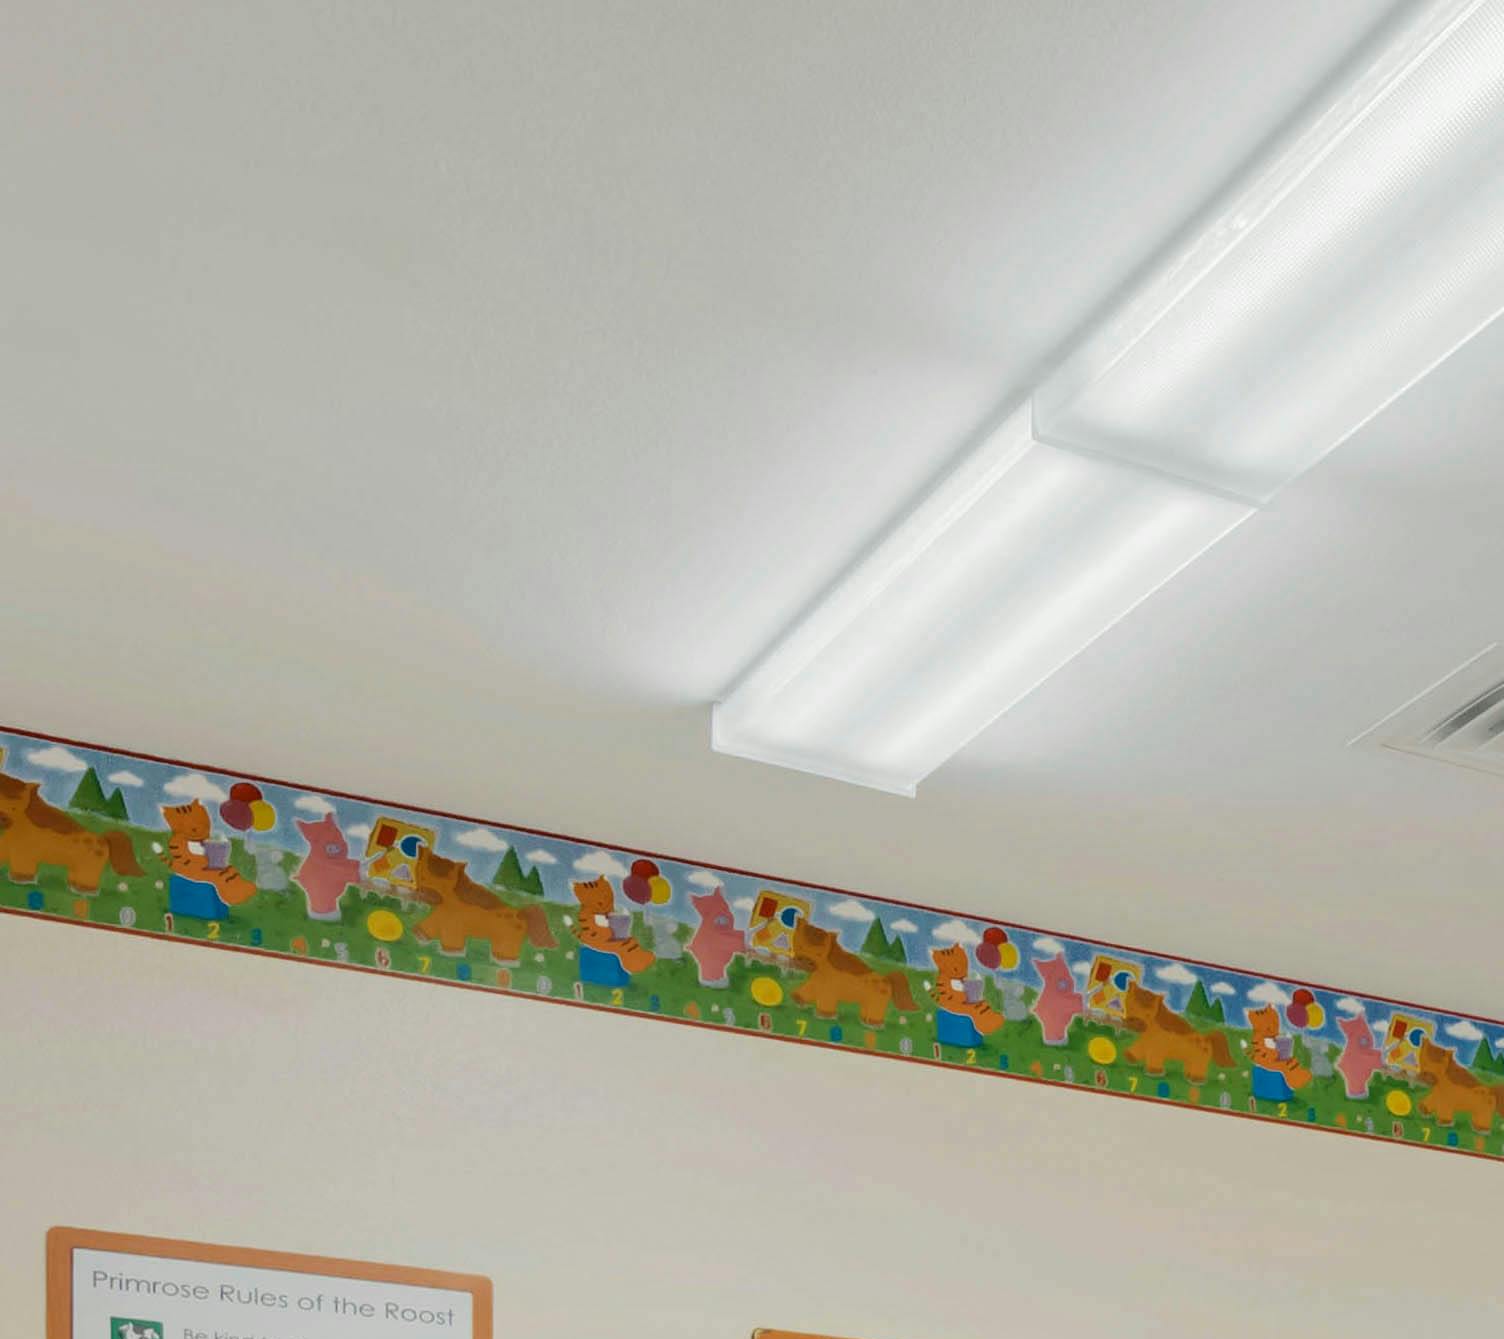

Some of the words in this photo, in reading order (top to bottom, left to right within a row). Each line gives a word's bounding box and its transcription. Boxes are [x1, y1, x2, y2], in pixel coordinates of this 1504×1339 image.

[165, 913, 173, 932] 1
[208, 921, 220, 939] 2
[418, 956, 431, 972] 7
[612, 989, 623, 1005] 2
[796, 1020, 807, 1036] 7
[967, 1049, 976, 1064] 2
[1129, 1077, 1138, 1093] 7
[1279, 1103, 1287, 1117] 2
[92, 1270, 209, 1300] Primrose
[220, 1284, 288, 1309] Rules
[298, 1294, 323, 1311] of
[334, 1296, 375, 1318] the
[385, 1302, 455, 1326] Roost
